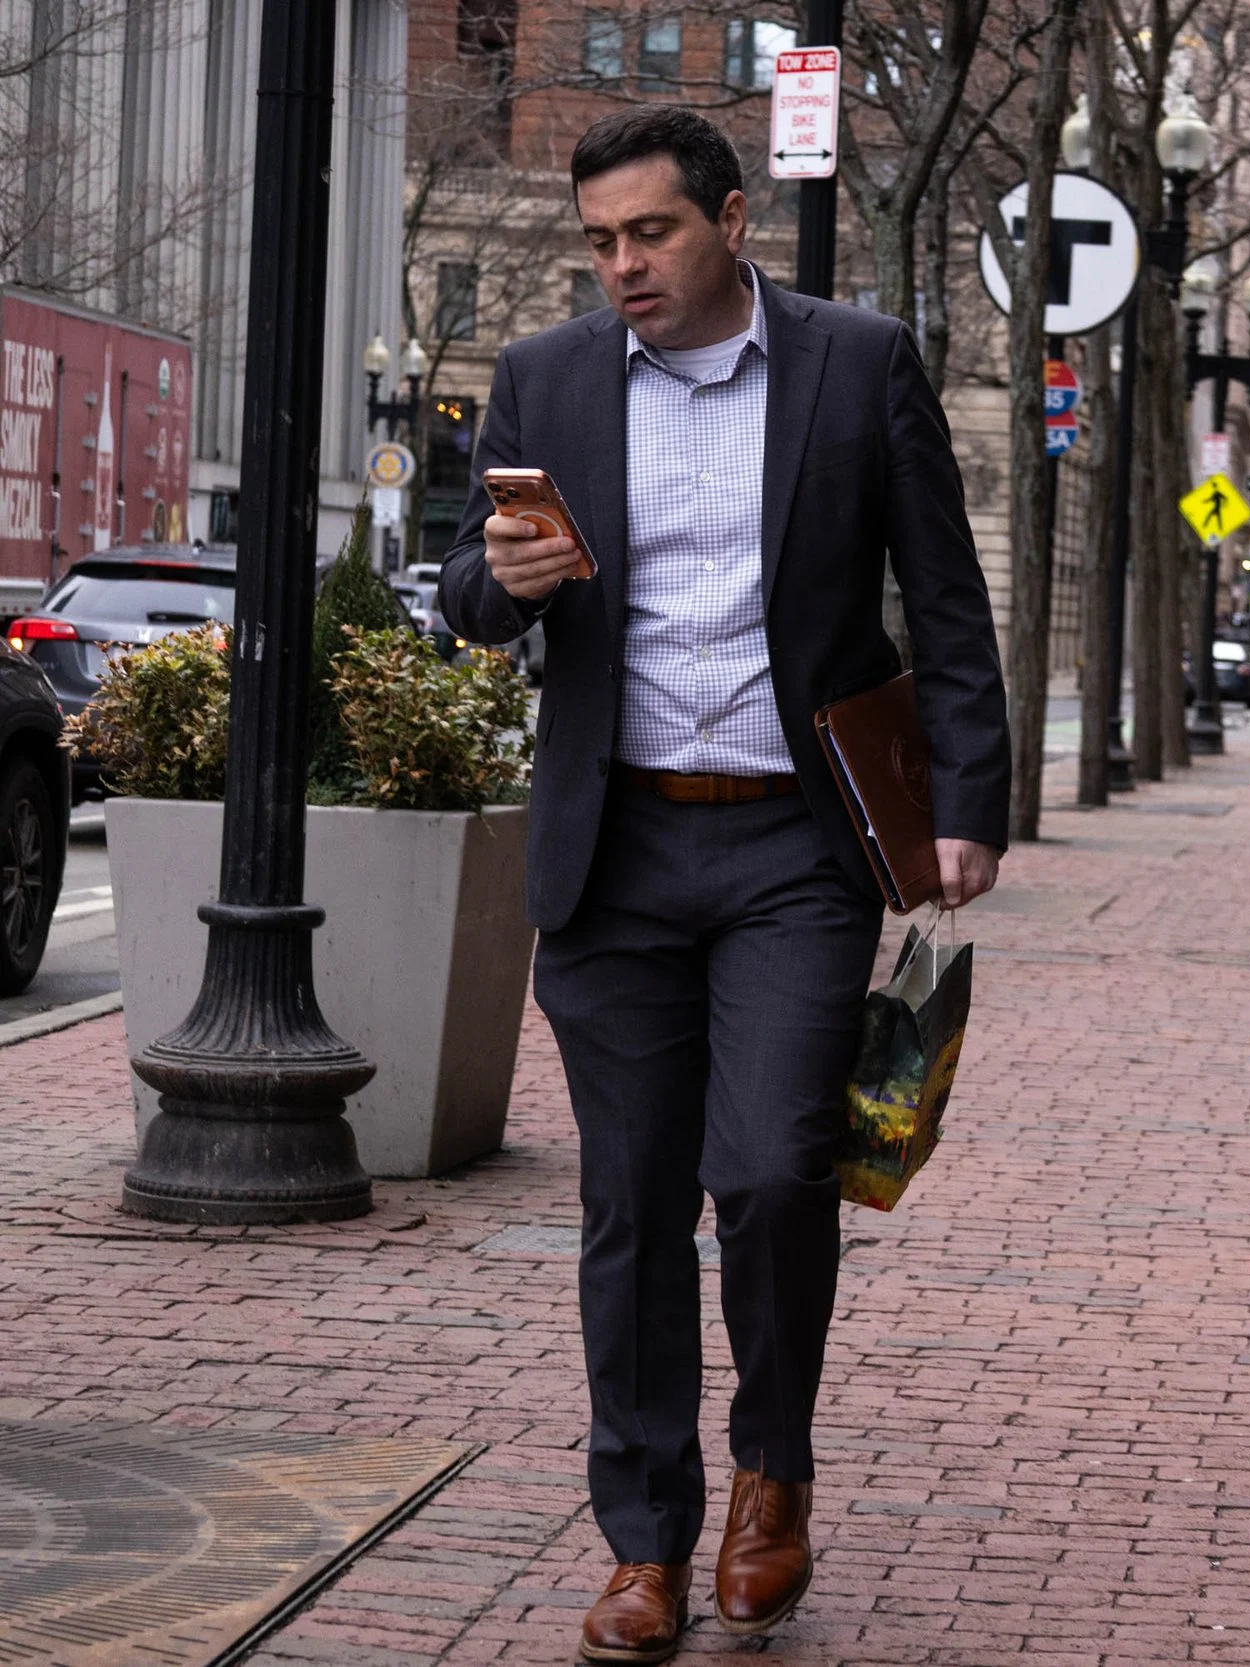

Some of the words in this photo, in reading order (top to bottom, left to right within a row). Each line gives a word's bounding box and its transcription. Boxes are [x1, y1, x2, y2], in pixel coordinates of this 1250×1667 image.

[779, 55, 803, 71] TOW
[804, 53, 835, 70] ZONE
[798, 77, 815, 89] NO
[780, 95, 830, 109] STOPPING
[792, 114, 816, 127] BIKE
[789, 132, 817, 146] LANE
[1012, 216, 1112, 306] T
[4, 340, 25, 404] THE
[26, 345, 54, 410] LESS
[0, 408, 41, 473] SMOKY
[0, 476, 43, 540] MEZCAL
